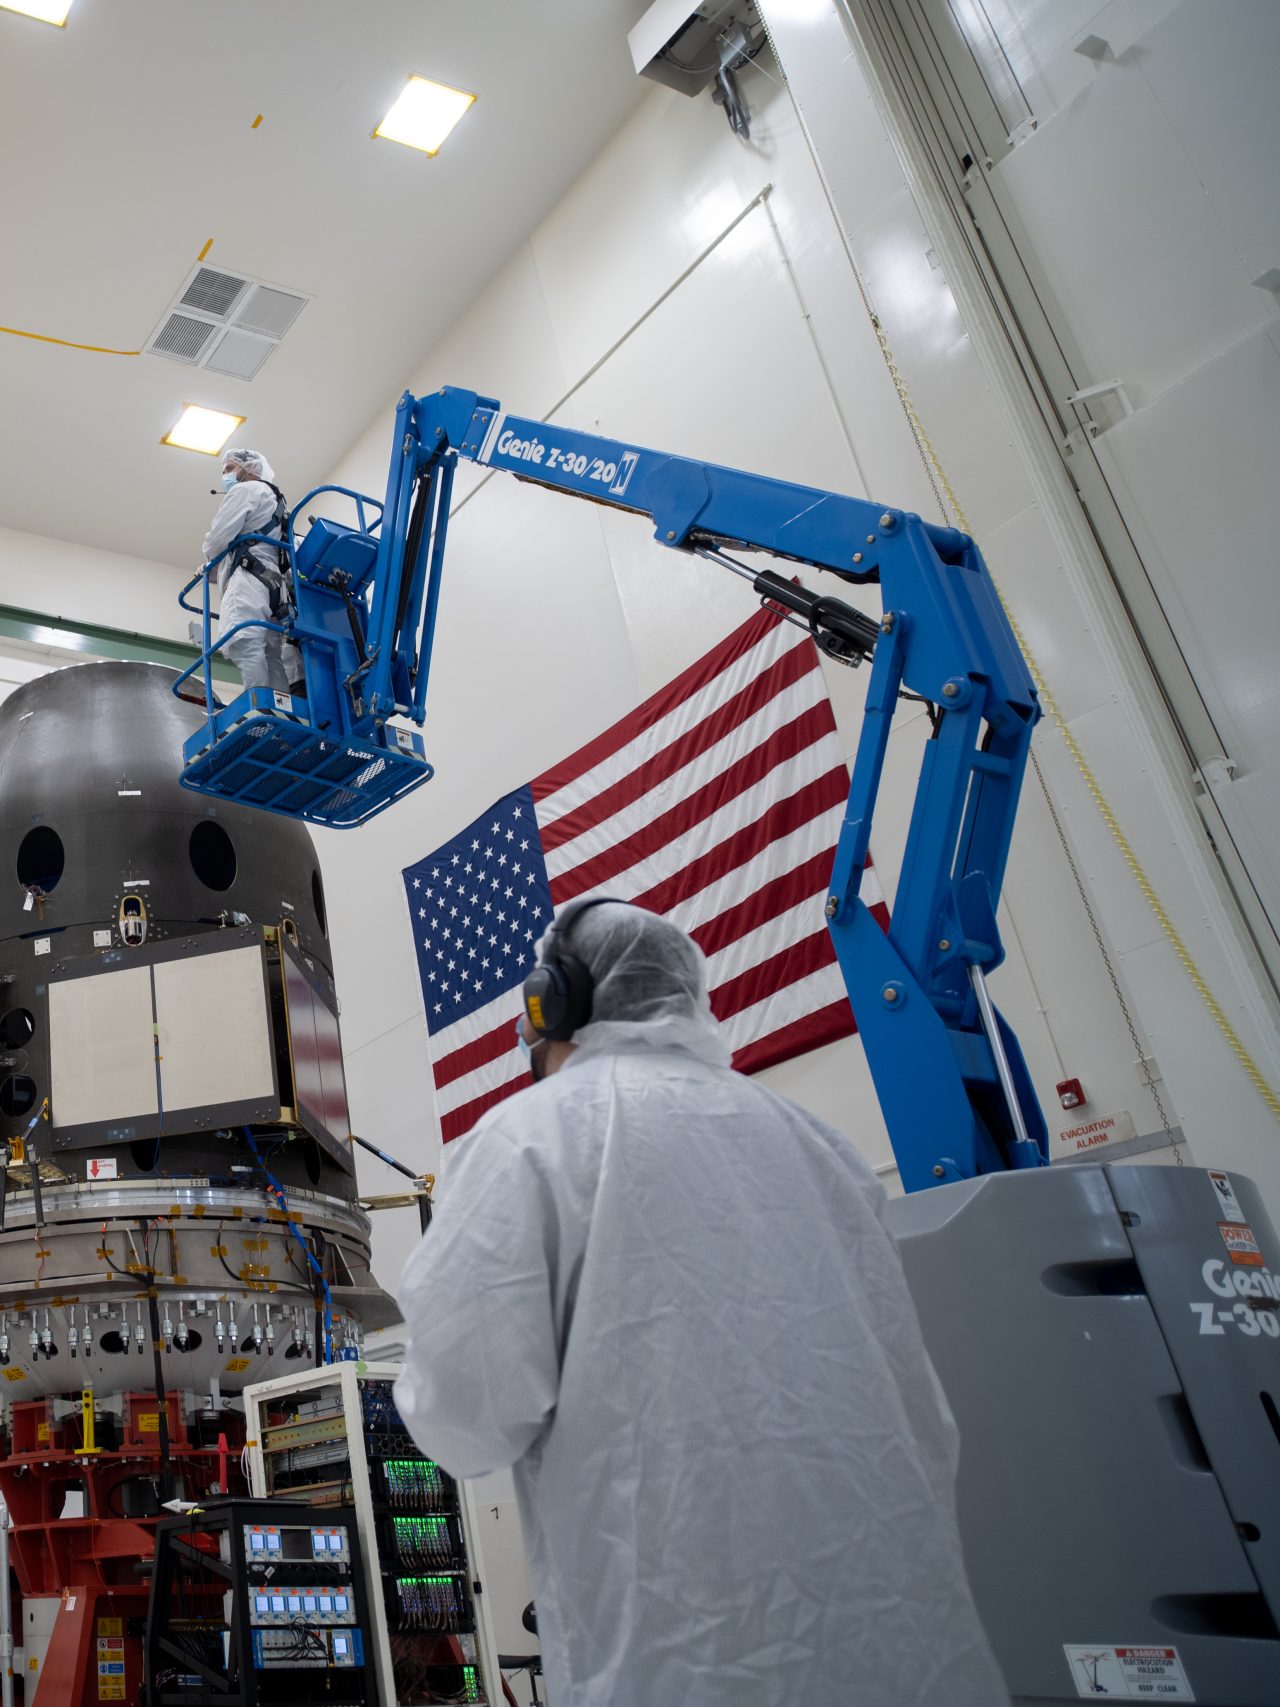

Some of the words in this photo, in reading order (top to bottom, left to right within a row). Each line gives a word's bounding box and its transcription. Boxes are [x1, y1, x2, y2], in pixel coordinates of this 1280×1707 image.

[497, 430, 545, 464] Genie
[1060, 1117, 1115, 1141] EVACUATION
[1076, 1133, 1109, 1150] ALARM
[1134, 1650, 1166, 1658] DANGER
[1137, 1666, 1165, 1674] HAZARD
[1157, 1685, 1178, 1693] CLEAR
